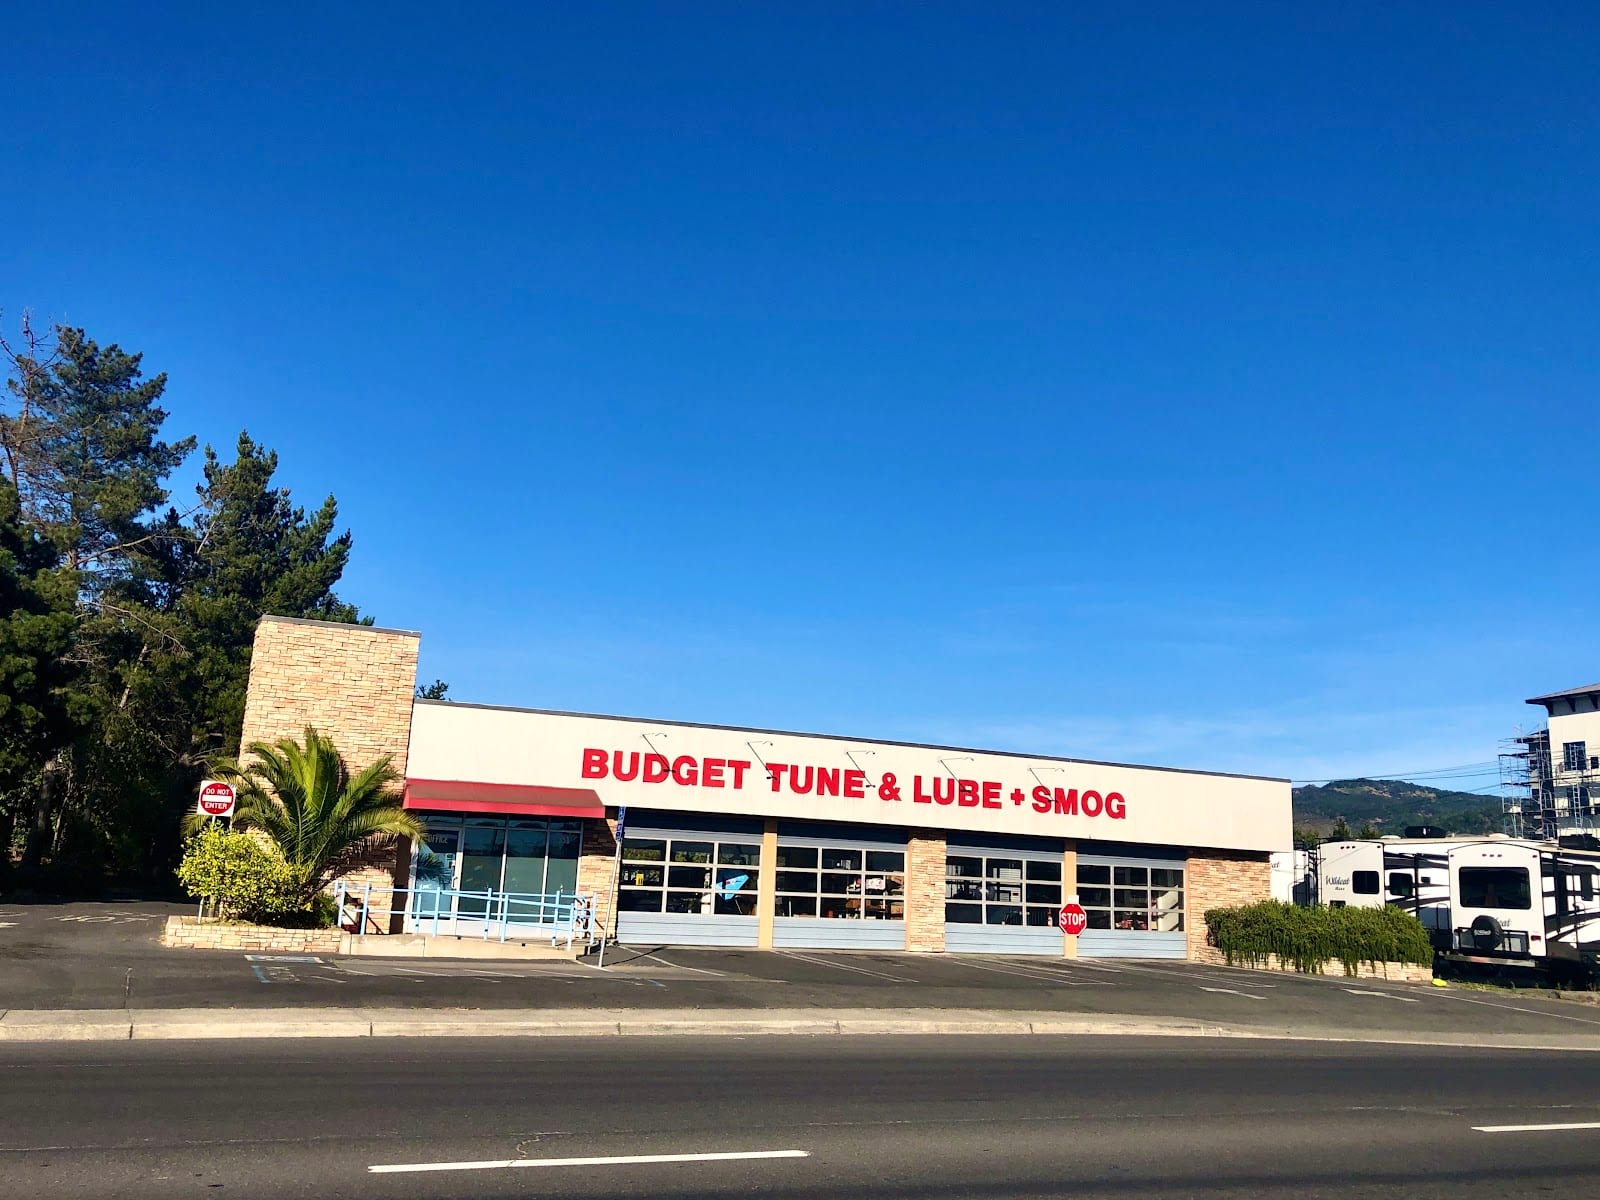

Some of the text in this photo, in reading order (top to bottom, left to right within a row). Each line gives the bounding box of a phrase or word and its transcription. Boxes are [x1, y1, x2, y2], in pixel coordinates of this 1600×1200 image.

[582, 748, 1126, 819] BUDGET TUNE & LUBE + SMOG
[1325, 875, 1350, 886] Wildcat
[1061, 912, 1085, 926] STOP
